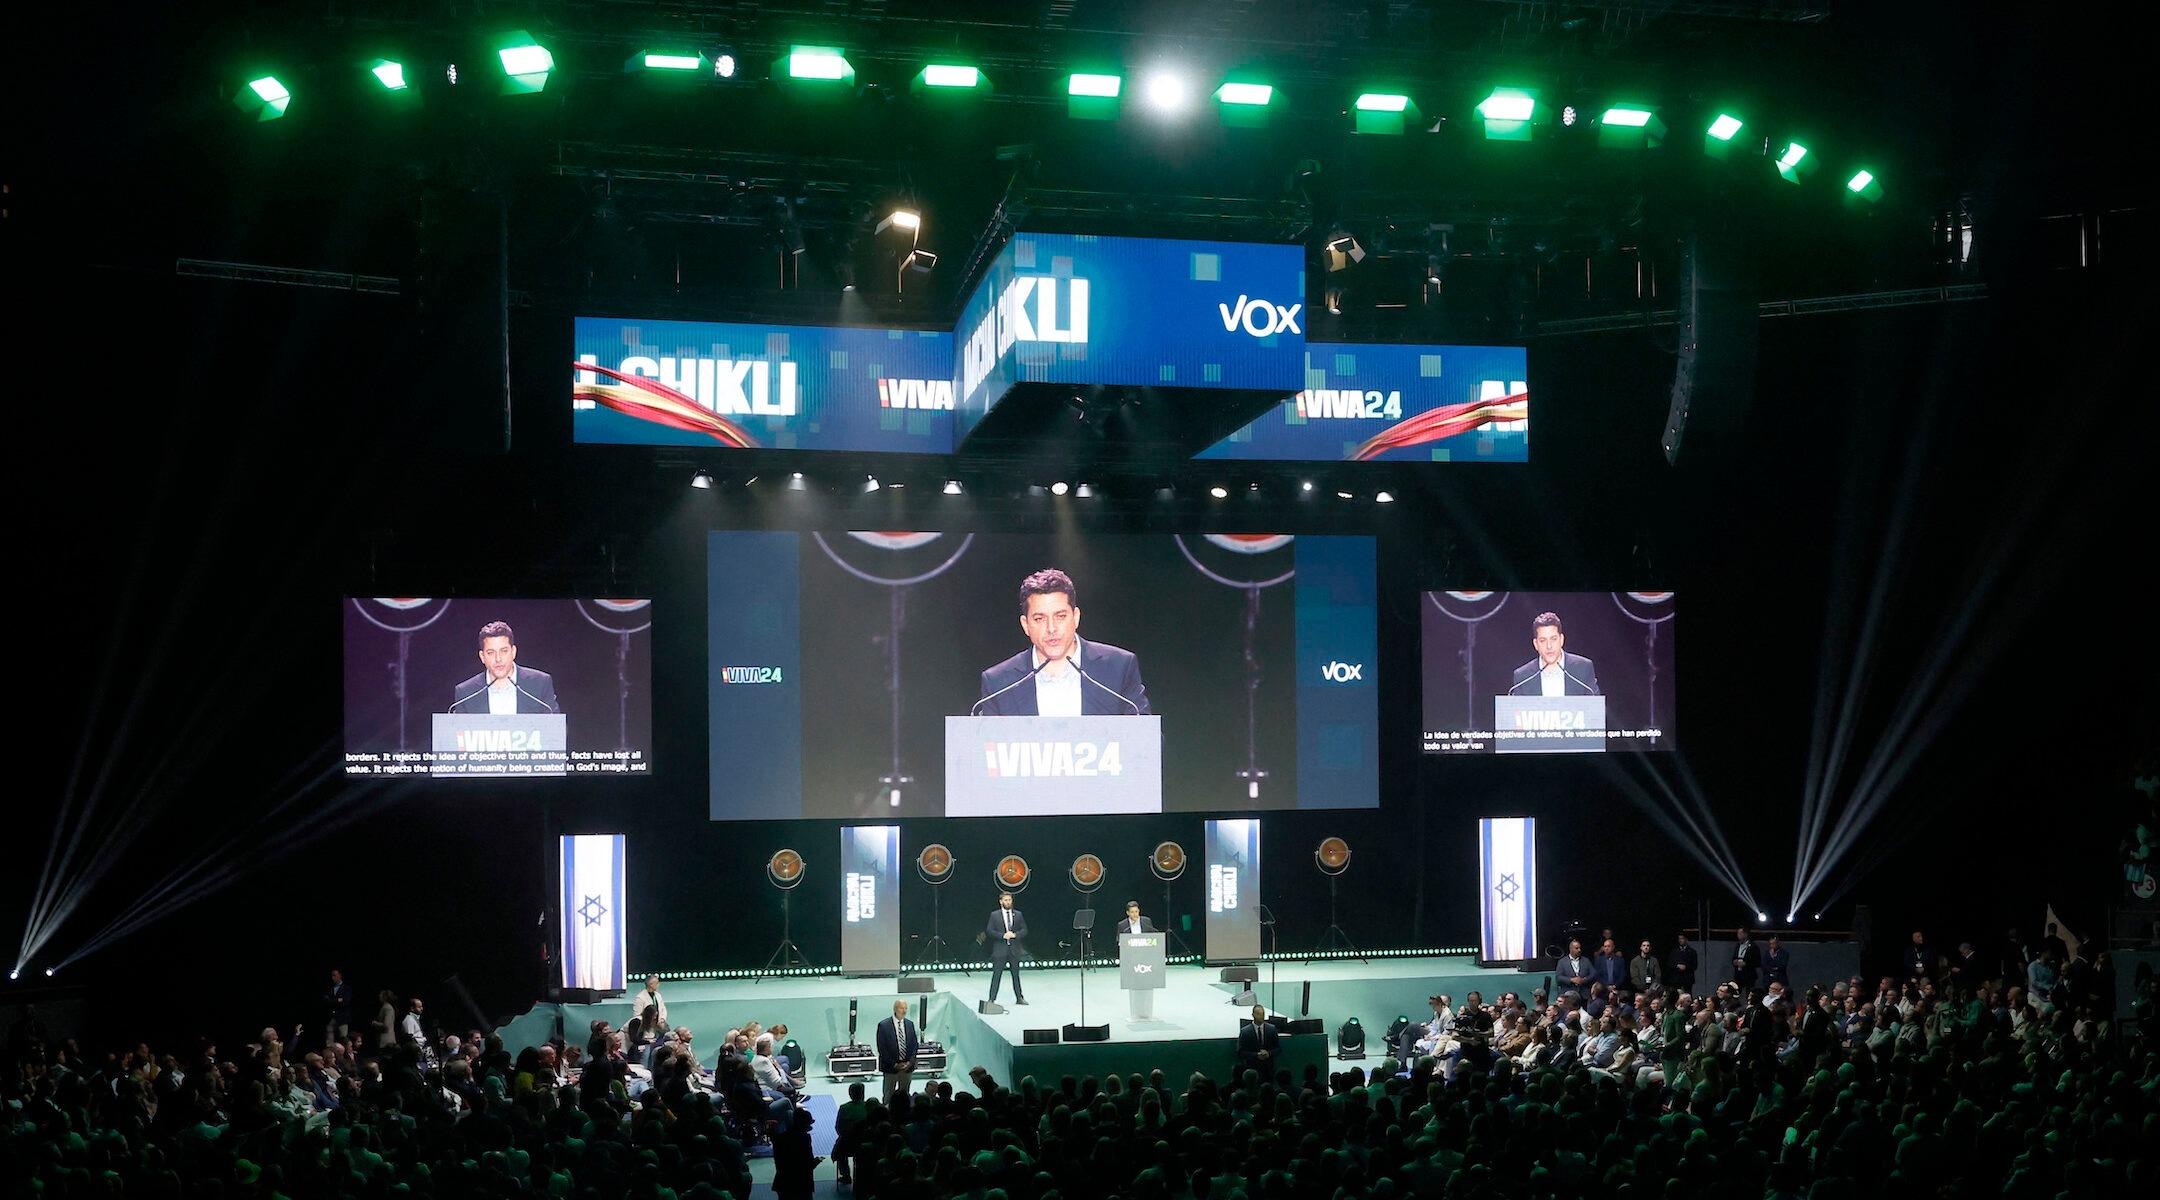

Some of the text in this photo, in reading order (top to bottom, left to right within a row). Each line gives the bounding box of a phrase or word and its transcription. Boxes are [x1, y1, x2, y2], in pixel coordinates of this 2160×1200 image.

[1218, 294, 1302, 338] VOX
[1321, 660, 1363, 683] VOX
[1423, 732, 1433, 740] La
[1434, 732, 1450, 740] idea
[1450, 731, 1460, 740] de
[1461, 731, 1493, 739] verdades
[1494, 731, 1525, 740] objetivas
[1526, 730, 1537, 738] de
[1537, 731, 1564, 739] valores,
[1564, 730, 1575, 738] de
[1575, 730, 1607, 738] verdades
[1607, 730, 1621, 739] que
[1635, 730, 1662, 739] perdido
[1424, 742, 1484, 750] todo su valor van
[345, 751, 641, 763] borders. It rejects the idea of objective truth and thus, facts have lost all
[345, 763, 646, 775] value. It rejects the notion of humanity being created in God's image, and
[1133, 963, 1153, 974] VOX
